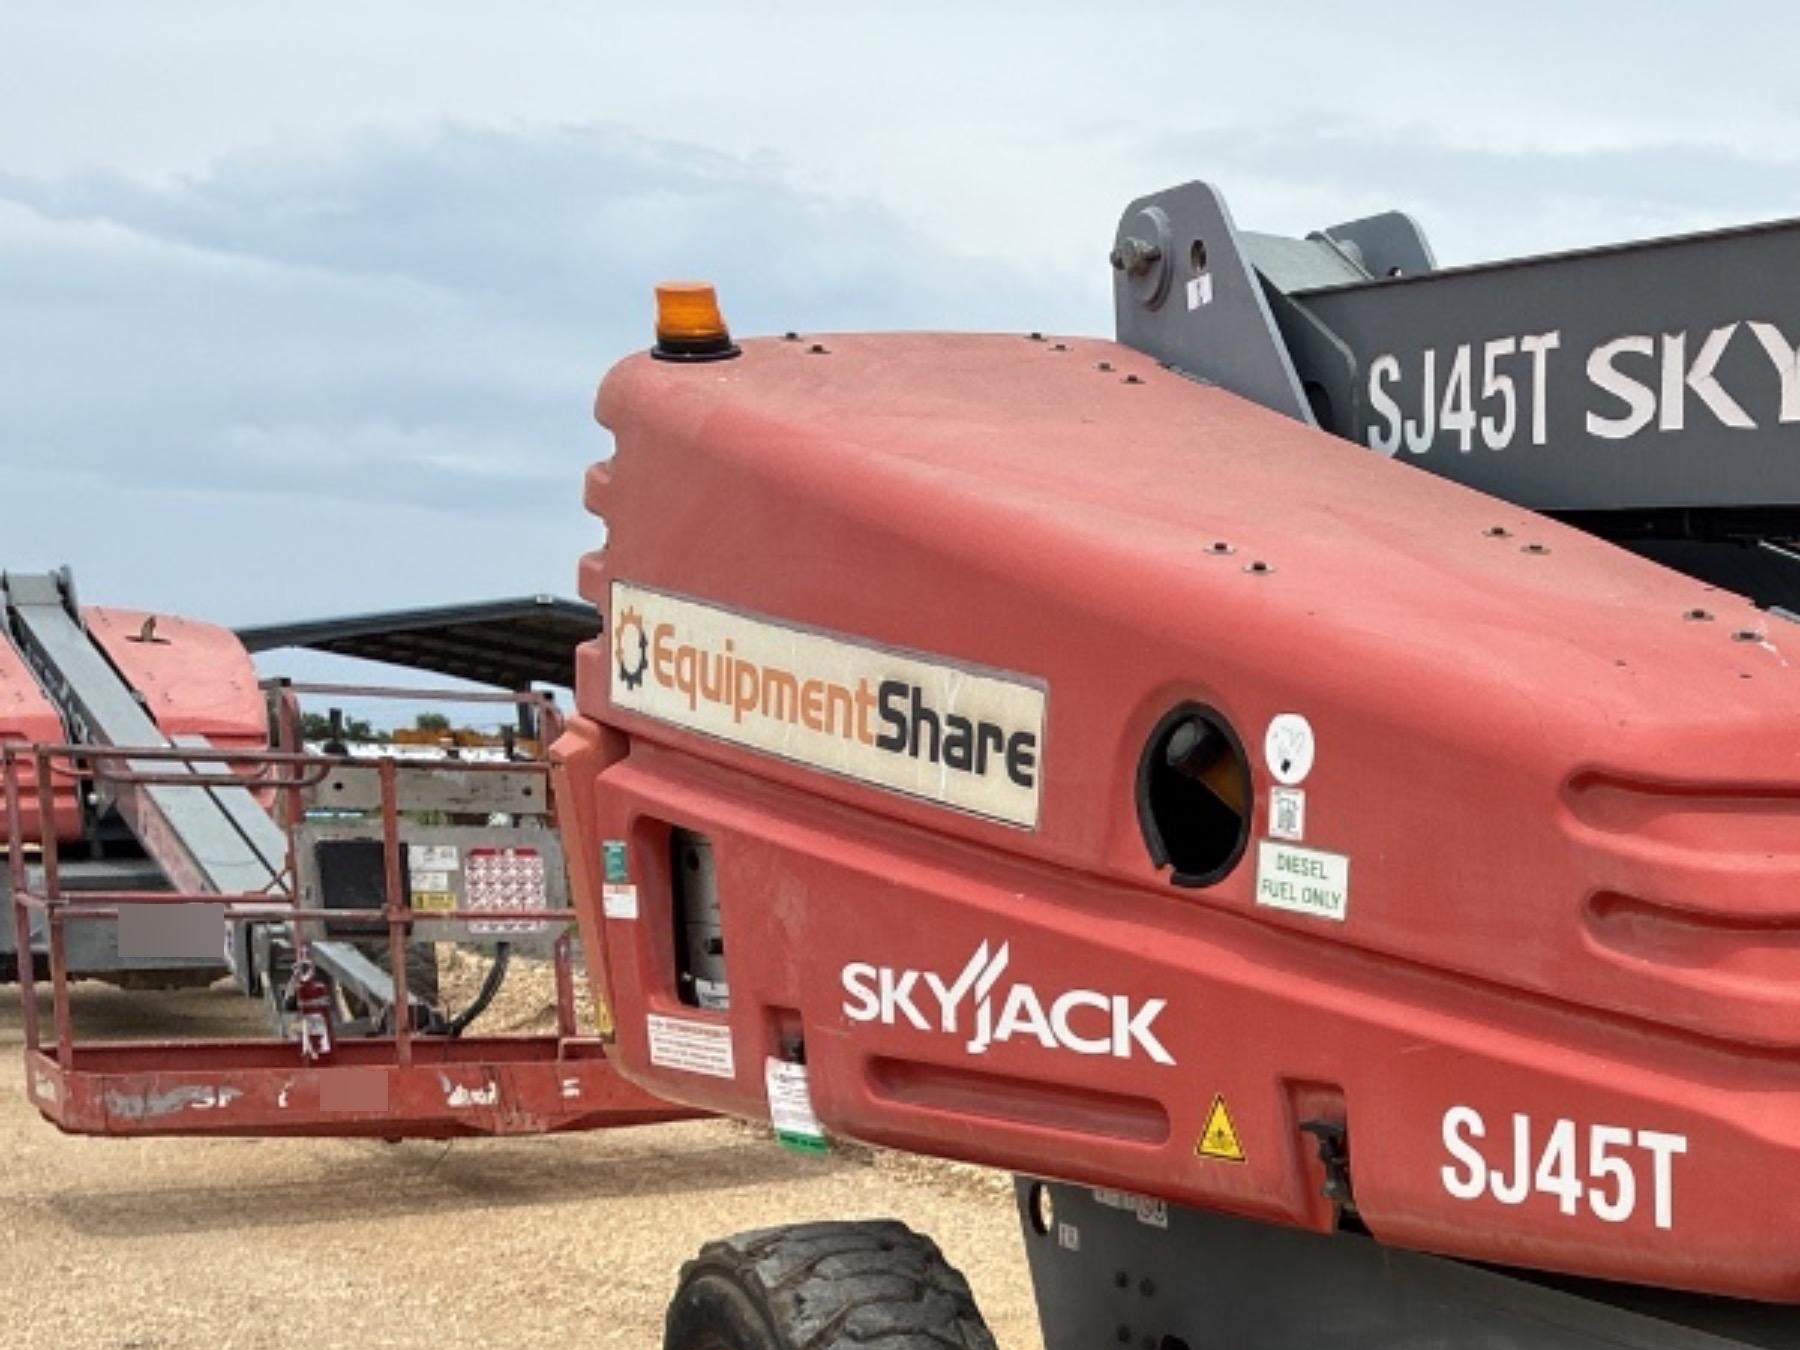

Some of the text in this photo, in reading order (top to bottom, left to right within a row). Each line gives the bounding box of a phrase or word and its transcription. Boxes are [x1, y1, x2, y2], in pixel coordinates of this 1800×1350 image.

[1368, 330, 1560, 457] SJ45T
[652, 621, 1037, 788] EquipmentShare
[1262, 877, 1342, 910] FUEL ONLY
[1276, 852, 1328, 881] DIESEL
[841, 937, 1178, 1066] SKYJACK
[1440, 1105, 1688, 1230] SJ45T
